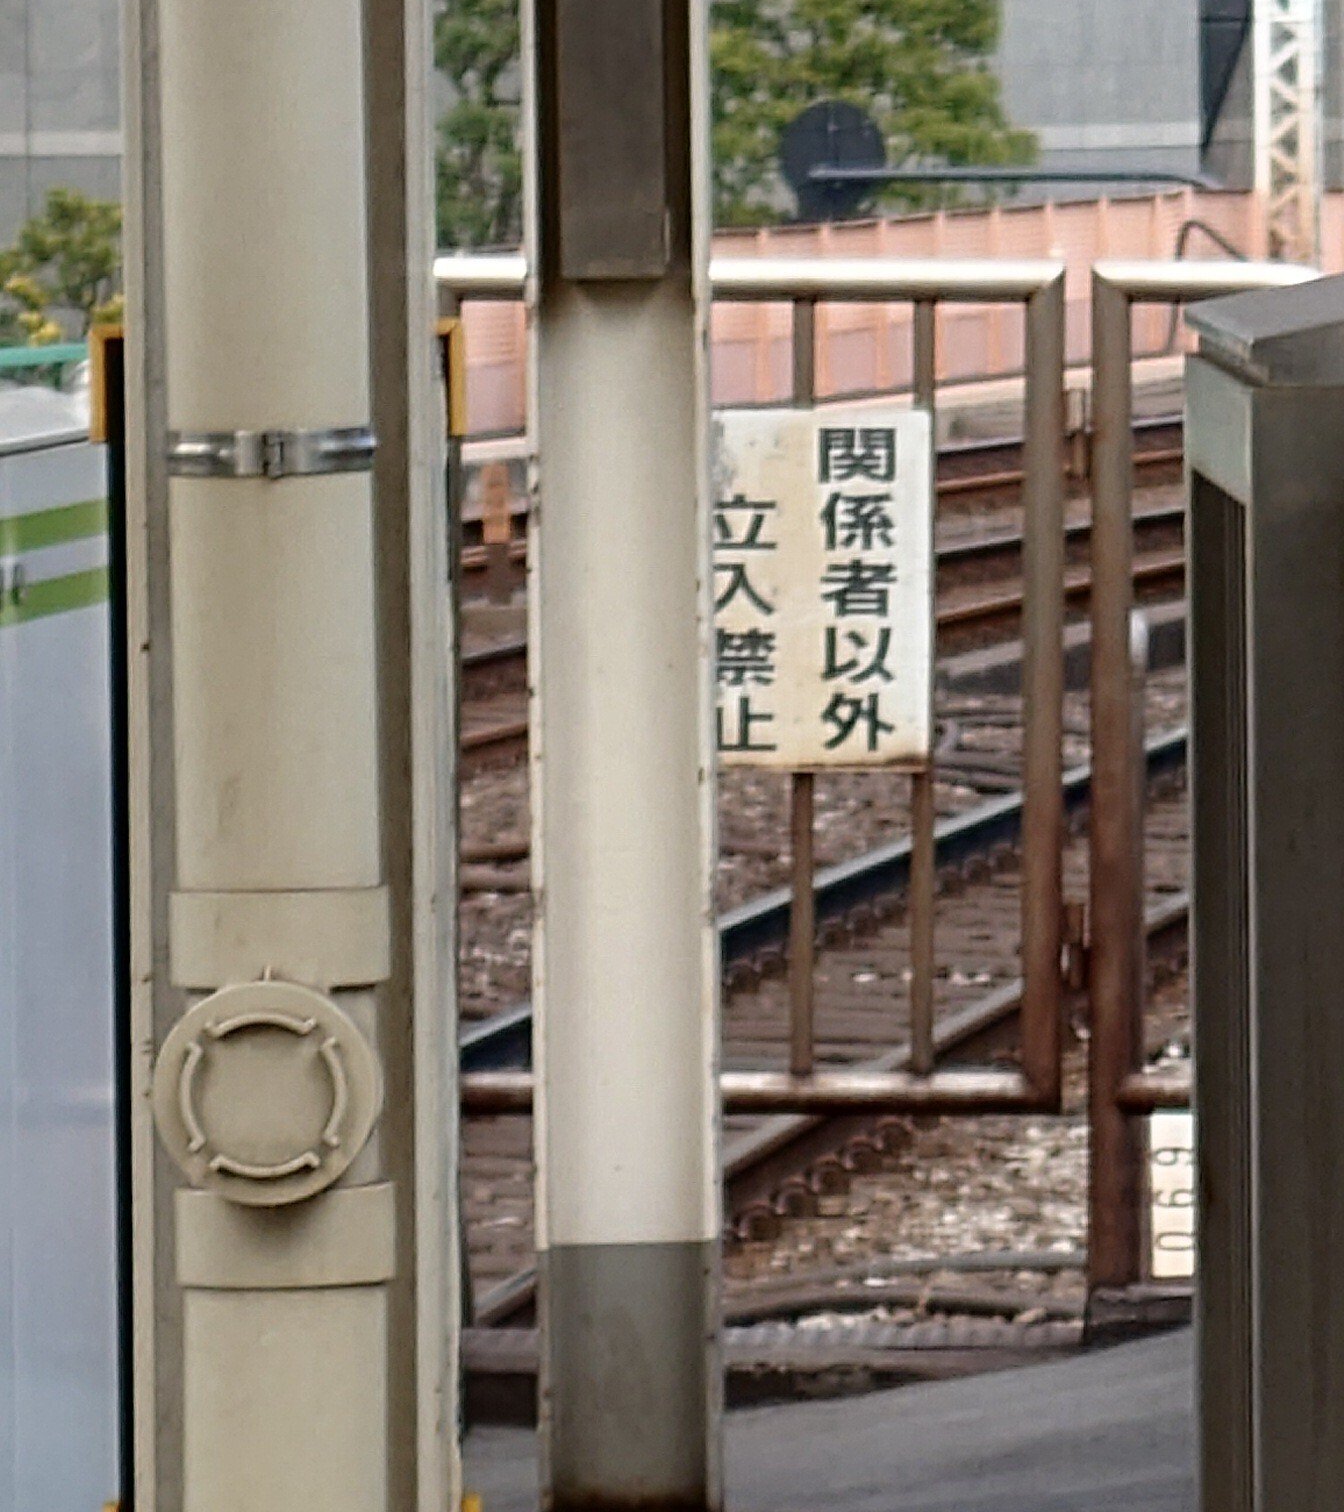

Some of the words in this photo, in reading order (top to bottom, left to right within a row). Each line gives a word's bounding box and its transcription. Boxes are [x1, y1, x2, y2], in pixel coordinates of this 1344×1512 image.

[713, 493, 777, 752] 立入禁止
[818, 428, 897, 752] 関係者以外
